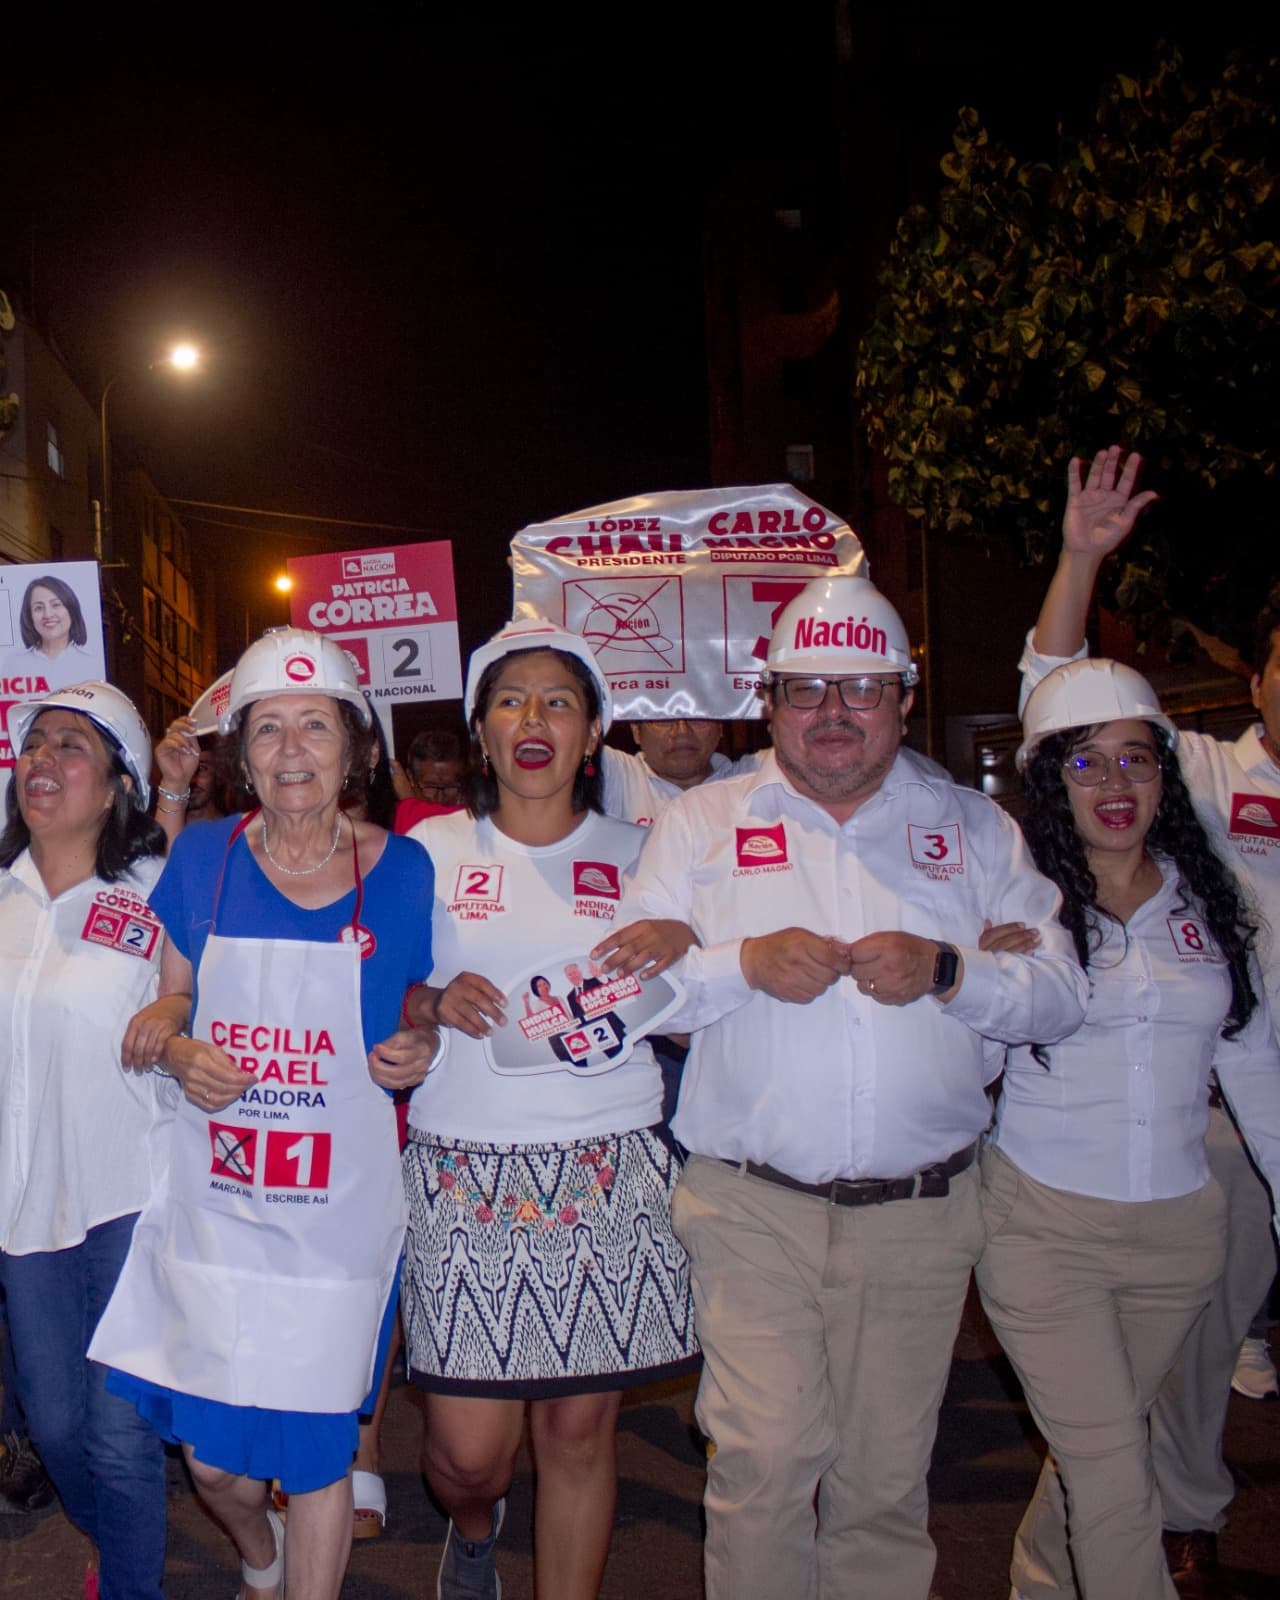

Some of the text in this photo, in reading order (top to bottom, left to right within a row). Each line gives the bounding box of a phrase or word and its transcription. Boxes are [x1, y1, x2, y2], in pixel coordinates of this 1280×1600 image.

[588, 515, 661, 533] LÓPEZ
[707, 506, 827, 536] CARLO
[576, 554, 687, 567] PRESIDENTE
[711, 552, 835, 564] DIPUTADO POR LIMA
[331, 577, 410, 598] PATRICIA
[308, 591, 438, 628] CORREA
[794, 616, 887, 656] Nación
[391, 638, 422, 678] 2
[0, 676, 50, 695] ICIA
[375, 684, 437, 698] NACIONAL
[610, 679, 639, 690] rca
[733, 677, 763, 690] Esc
[923, 834, 949, 861] 3
[1241, 844, 1268, 856] LIMA
[732, 863, 793, 877] CARLO MAGNO
[912, 861, 965, 875] DIPUTADO
[465, 871, 490, 895] 2
[446, 902, 506, 913] DIPUTADA
[576, 900, 615, 912] INDIRA
[459, 911, 489, 921] LIMA
[126, 928, 145, 947] 2
[1181, 922, 1204, 950] 8
[210, 1021, 337, 1057] CECILIA
[593, 1027, 609, 1043] 2
[227, 1053, 329, 1087] RAEL
[239, 1088, 327, 1108] NADORA
[238, 1108, 290, 1121] POR LIMA
[286, 1135, 315, 1187] 1
[209, 1180, 241, 1196] MARCA
[265, 1193, 311, 1204] ESCRIBE
